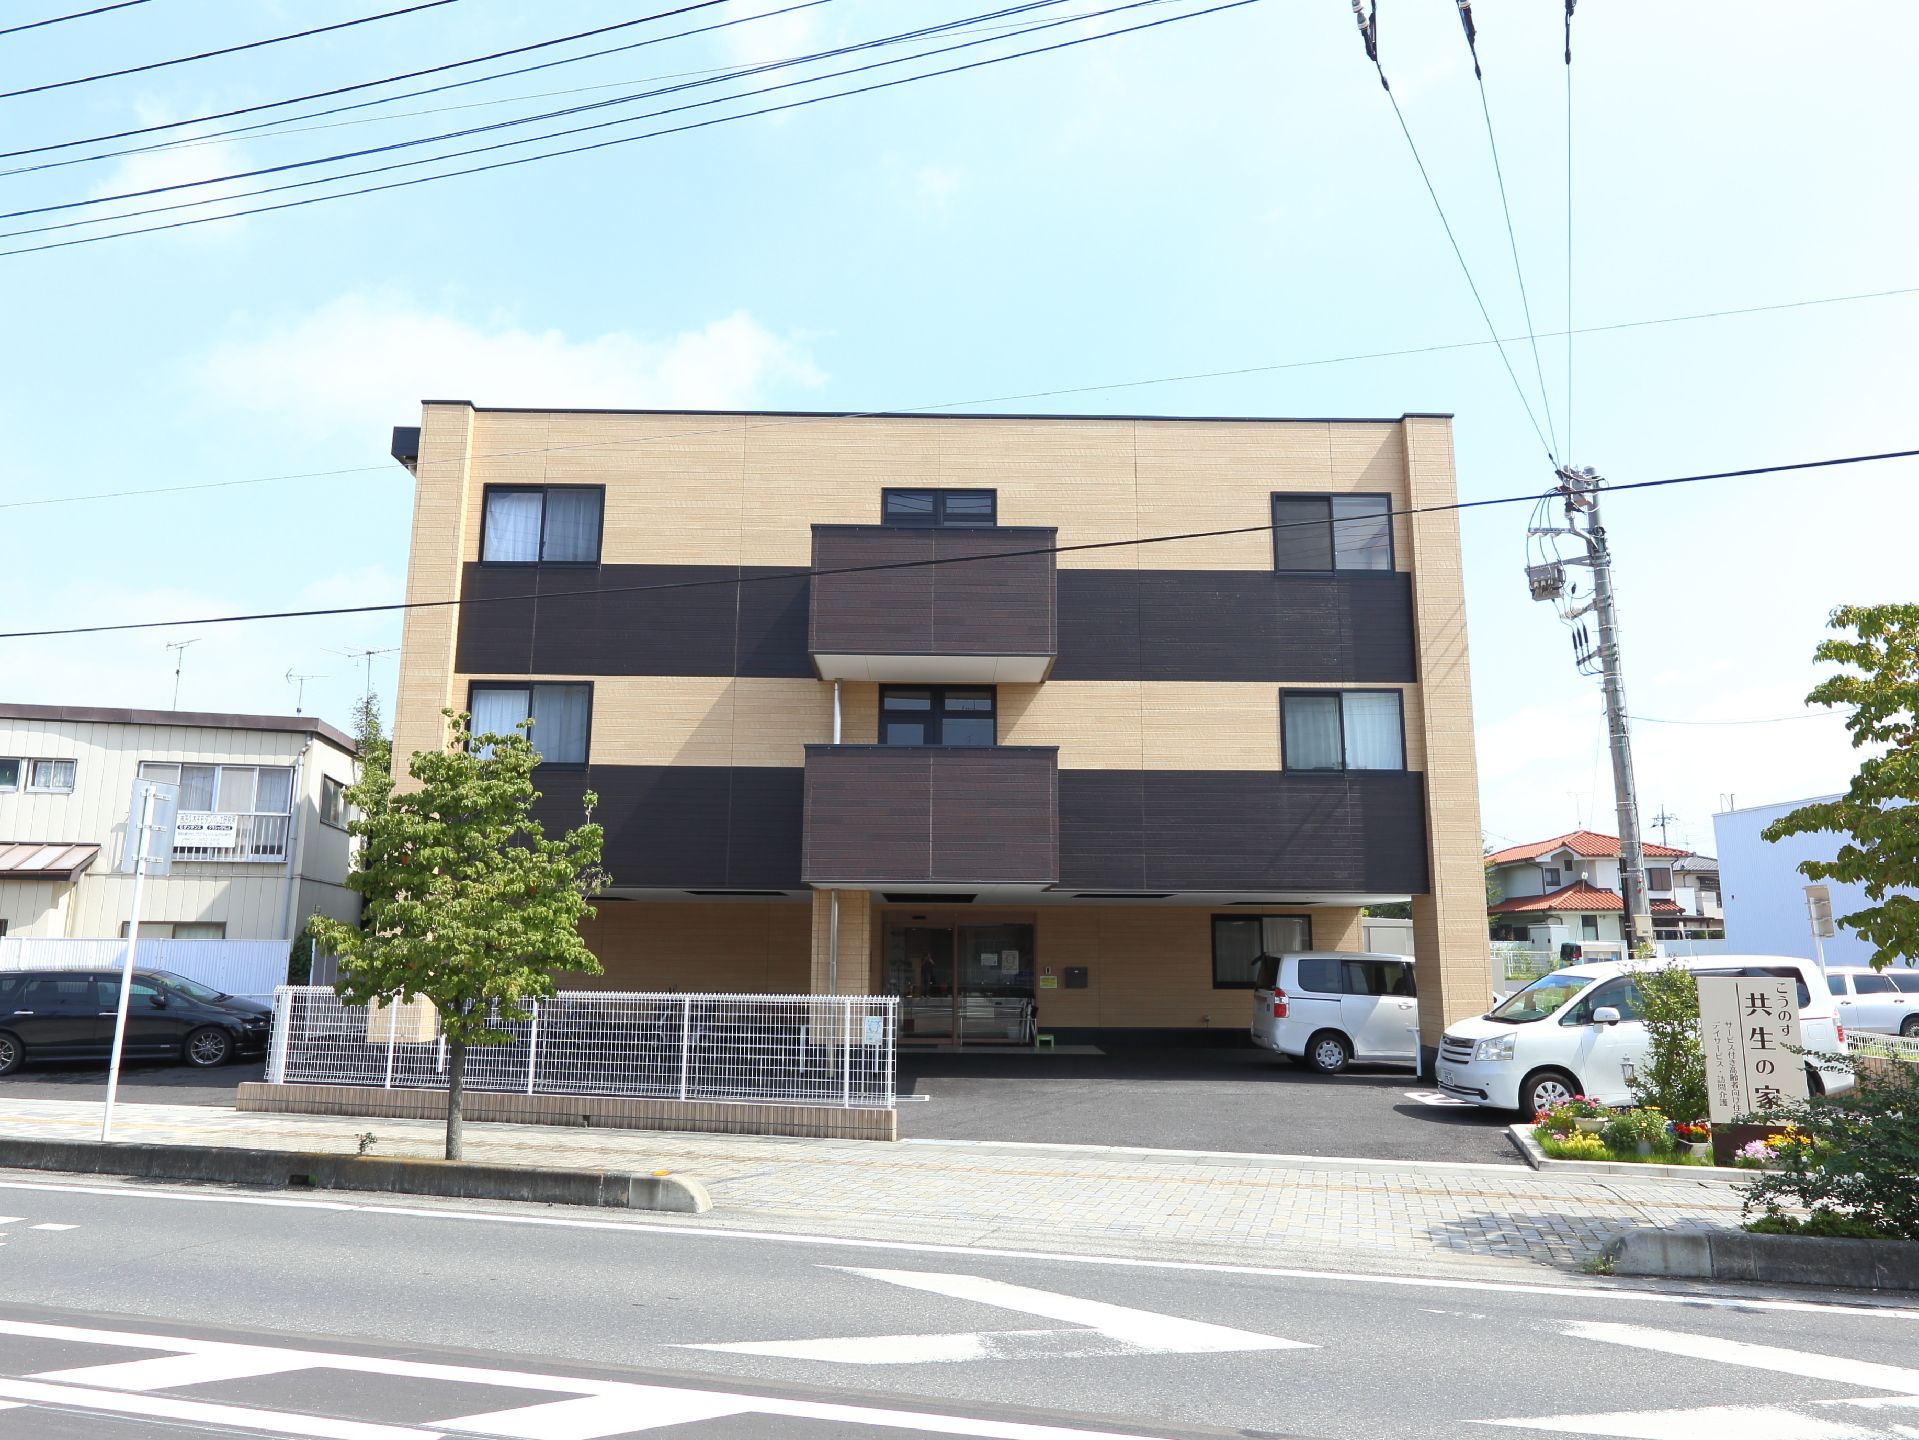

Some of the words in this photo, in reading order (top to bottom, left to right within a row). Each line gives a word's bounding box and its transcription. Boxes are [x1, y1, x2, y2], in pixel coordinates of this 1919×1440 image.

[1745, 992, 1780, 1110] 共生の家
[1776, 982, 1793, 1037] こうのす
